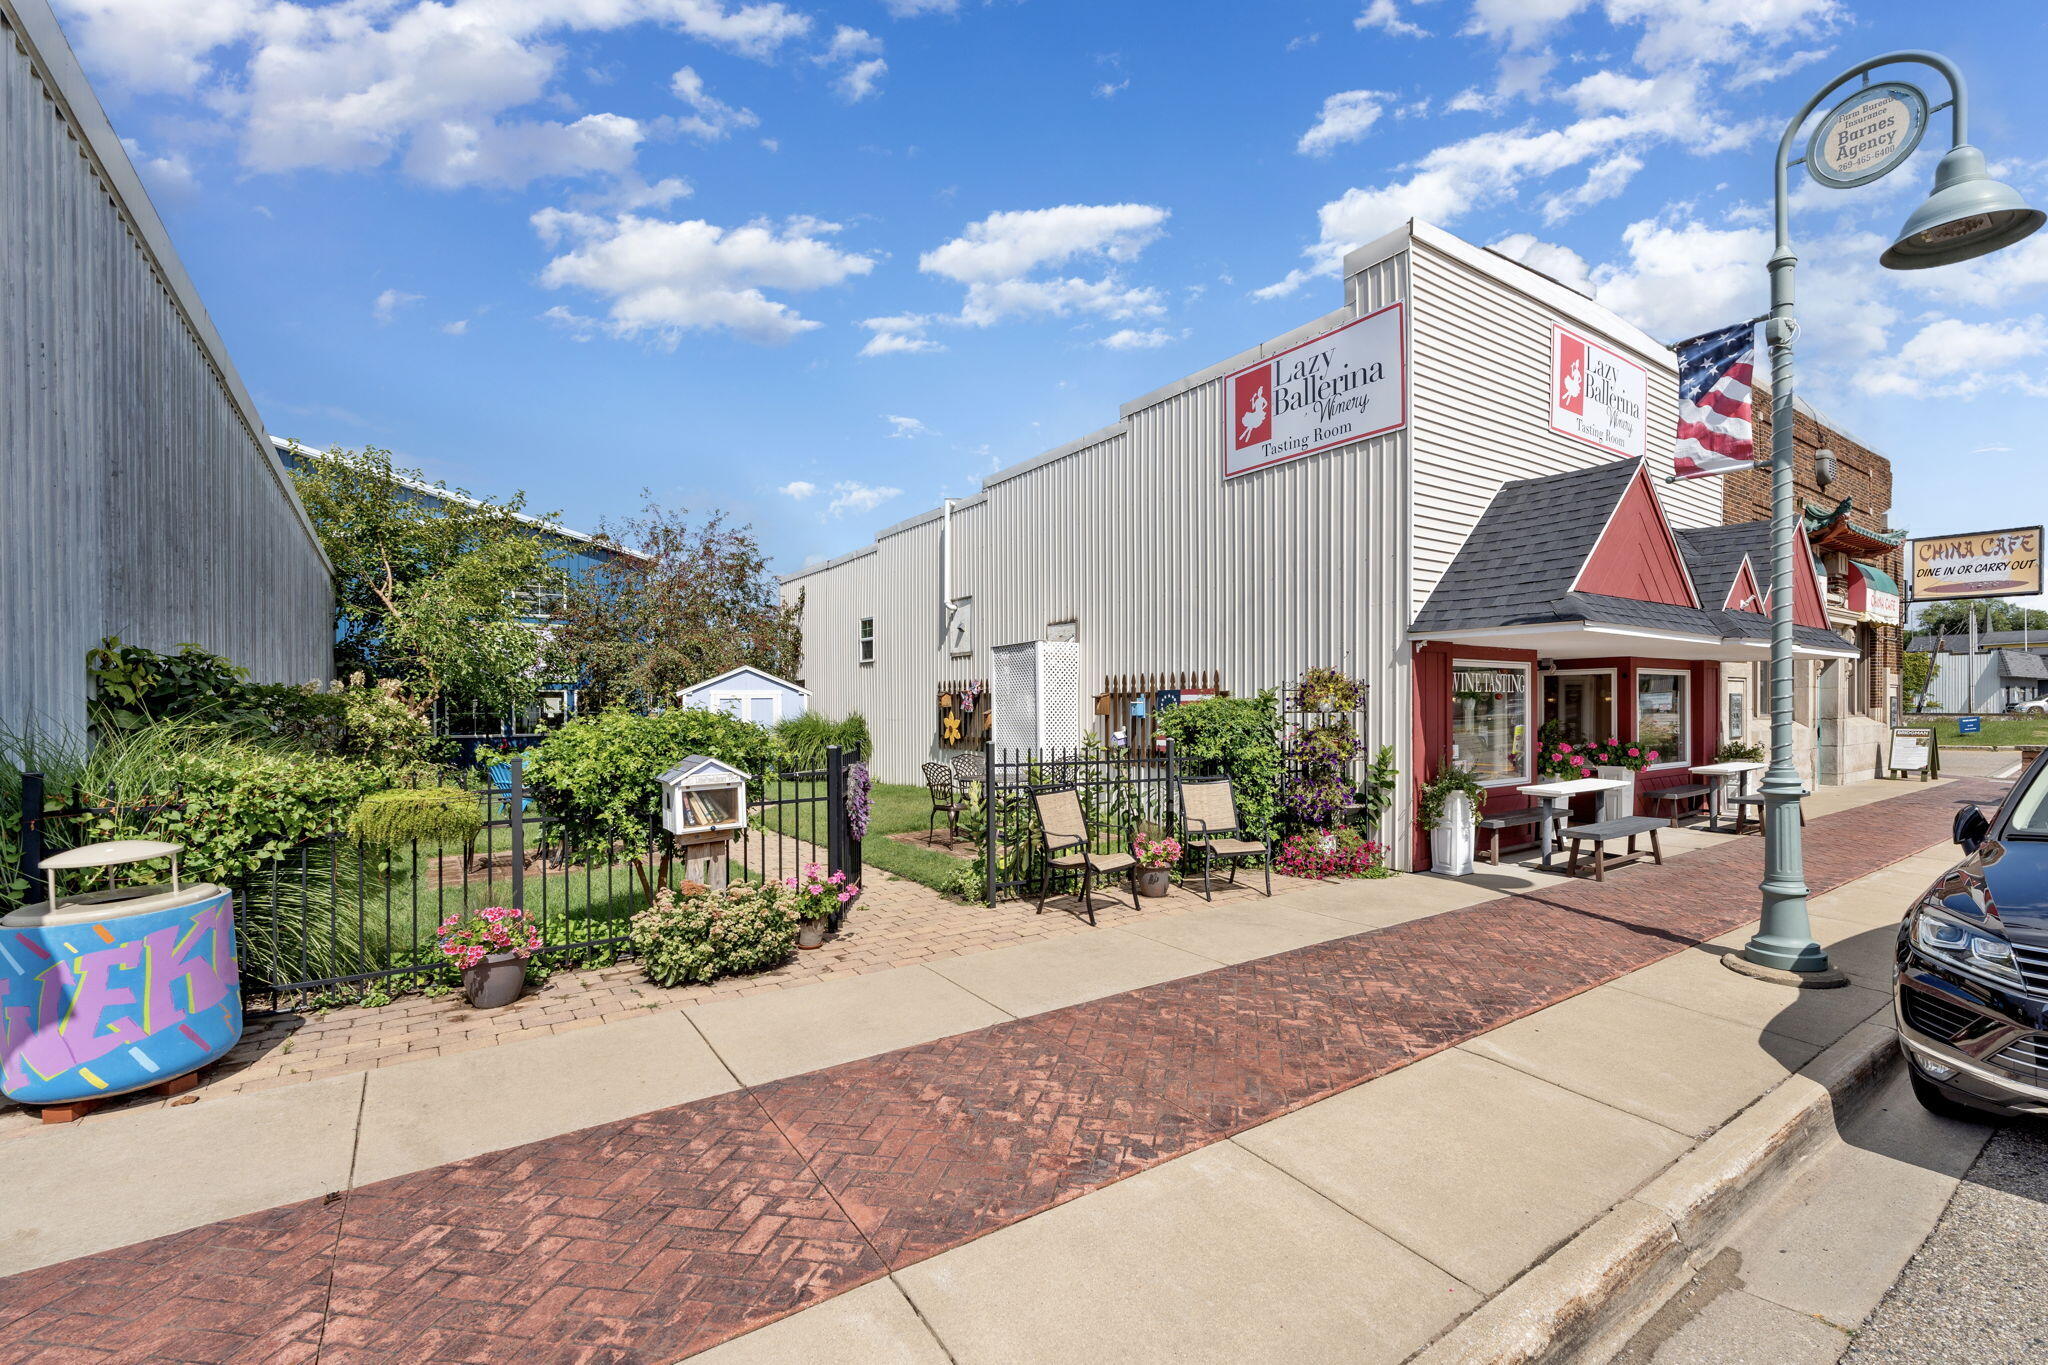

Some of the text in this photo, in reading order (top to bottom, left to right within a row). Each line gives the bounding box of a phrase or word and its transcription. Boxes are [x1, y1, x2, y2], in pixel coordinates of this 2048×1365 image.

[1838, 97, 1896, 123] Farm Bureau
[1845, 108, 1887, 129] Insurance
[1836, 129, 1897, 161] Agency
[1838, 115, 1895, 146] Barnes
[1838, 144, 1895, 172] 269-465-6400
[1273, 347, 1336, 388] Lazy
[1585, 346, 1619, 390] Lazy
[1273, 361, 1385, 417] Ballerina
[1585, 373, 1640, 419] Ballerina
[1313, 392, 1370, 423] Winery
[1606, 406, 1633, 438] Winery
[1262, 422, 1352, 457] Tasting Room
[1576, 417, 1625, 448] Tasting Room
[1919, 533, 2034, 562] CHINA CAFE
[1916, 559, 2037, 578] DINE IN OR CARRY OUT
[1482, 673, 1525, 693] TASTING
